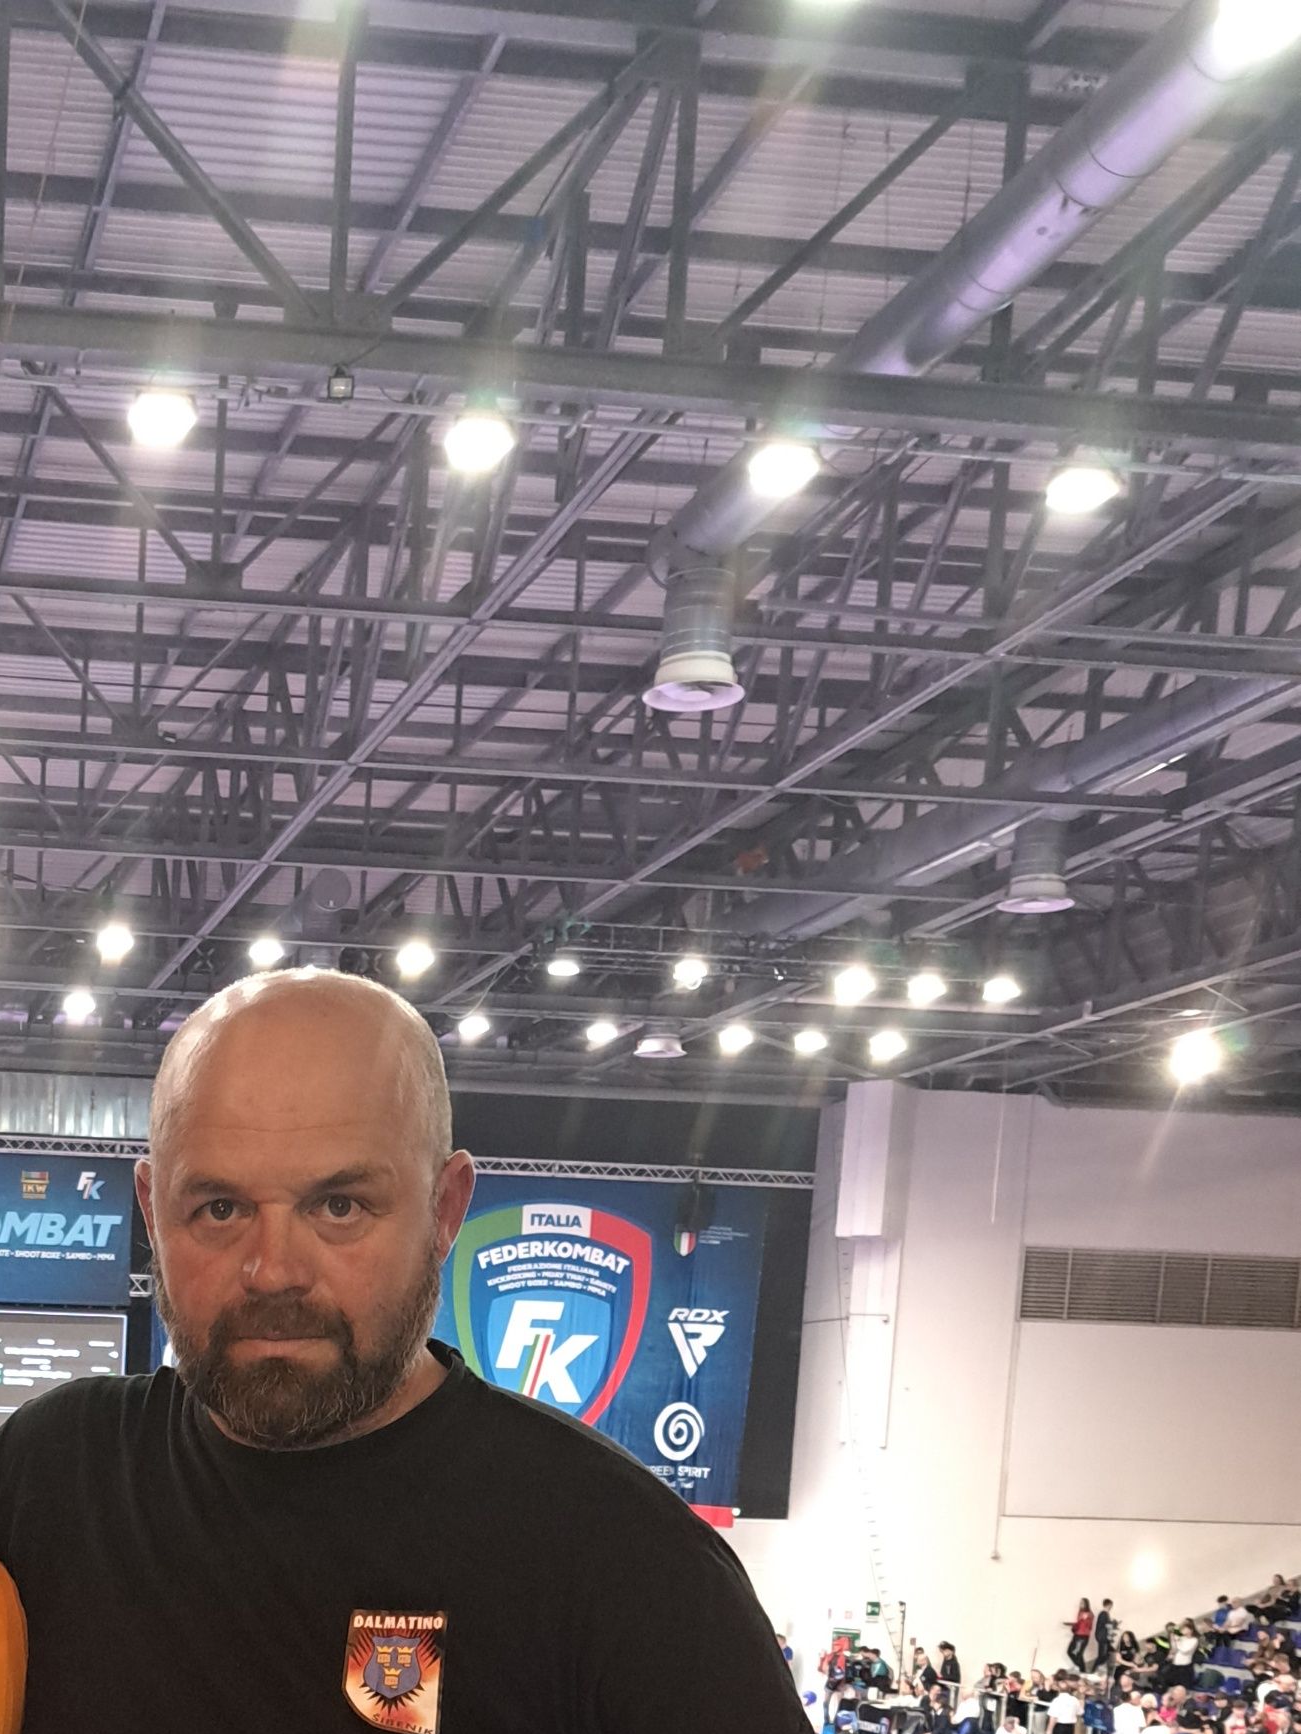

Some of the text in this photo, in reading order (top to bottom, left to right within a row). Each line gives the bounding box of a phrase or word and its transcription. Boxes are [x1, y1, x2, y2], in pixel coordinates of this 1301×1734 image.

[530, 1213, 582, 1228] ITALIA
[477, 1240, 630, 1275] FEDERKOMBAT
[667, 1307, 730, 1324] RDX
[677, 1465, 712, 1479] SPIRIT
[353, 1615, 444, 1630] DALMATINO
